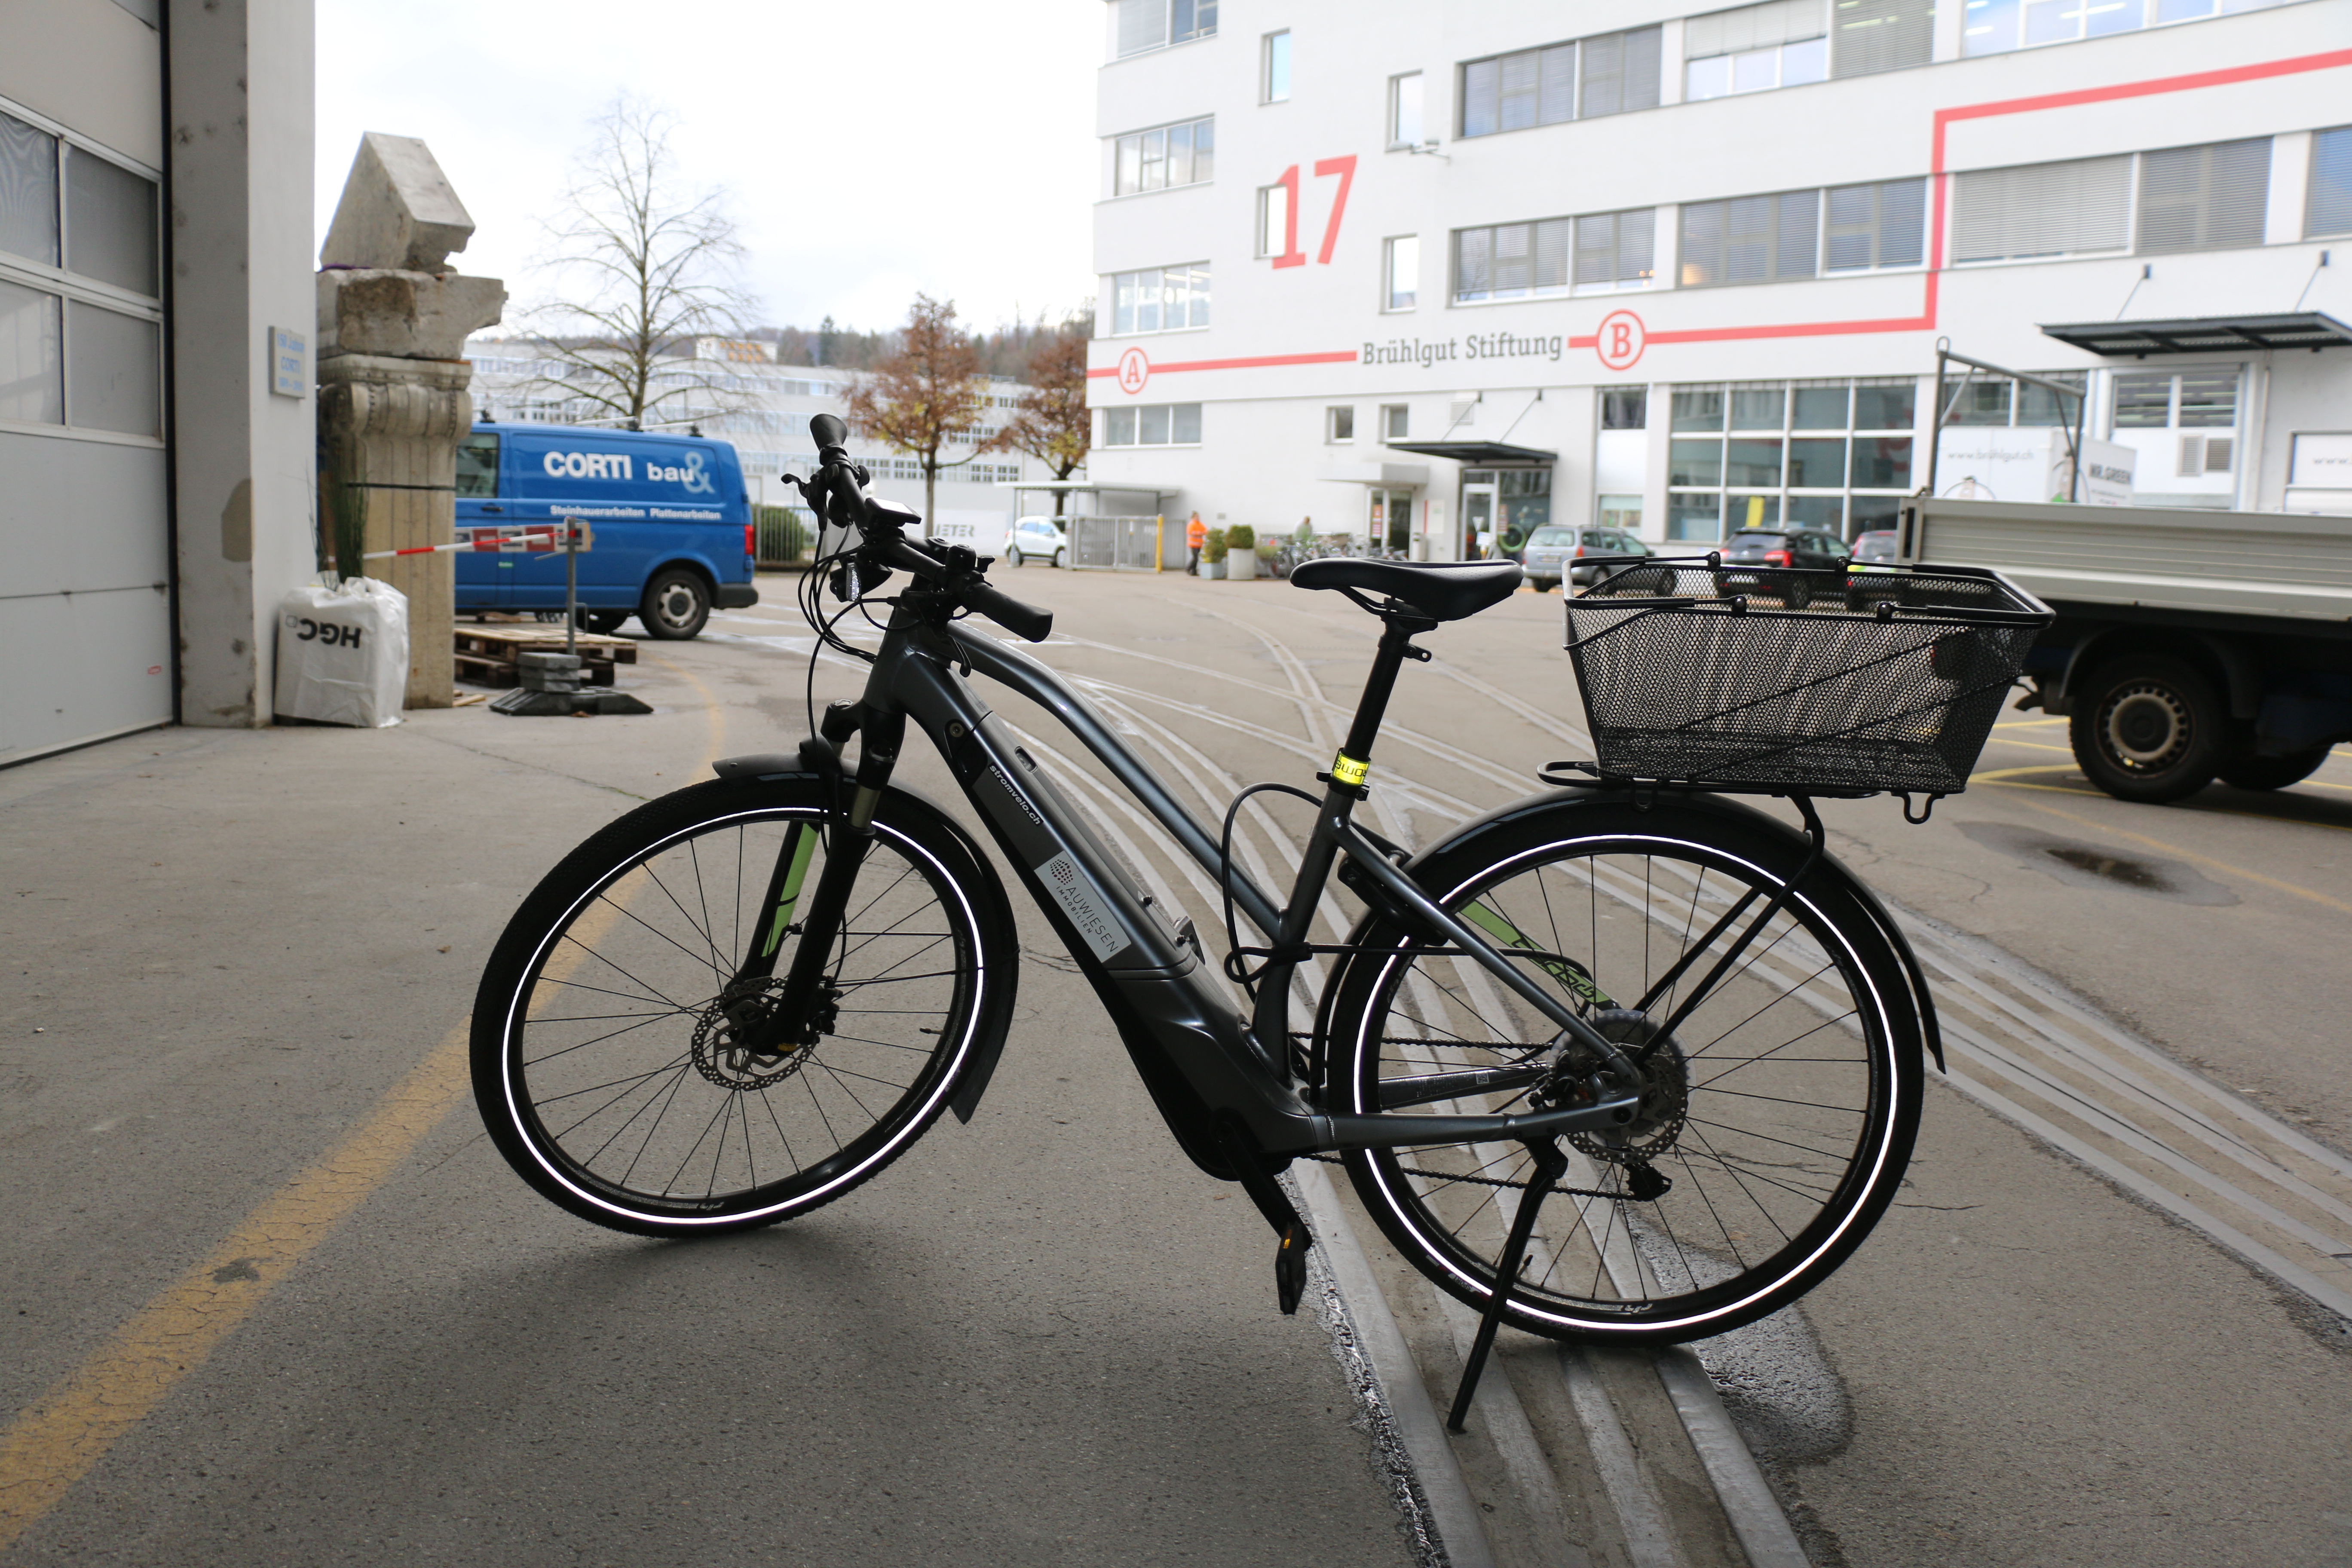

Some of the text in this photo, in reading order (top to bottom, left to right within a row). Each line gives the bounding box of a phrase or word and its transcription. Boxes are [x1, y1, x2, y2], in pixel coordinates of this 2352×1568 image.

[1272, 153, 1357, 270] 17
[1362, 331, 1562, 368] Brühlgut Stiftung
[1609, 322, 1632, 359] B
[1125, 355, 1141, 384] A
[543, 451, 632, 480] CORTI
[550, 504, 722, 521] Steinhauerarbeiten Plattenarbeiten
[296, 618, 361, 649] HGC
[989, 764, 1041, 826] stromvelo.ch
[1056, 885, 1092, 934] IMMOBILIEN
[1066, 885, 1118, 953] AUWIESEN
